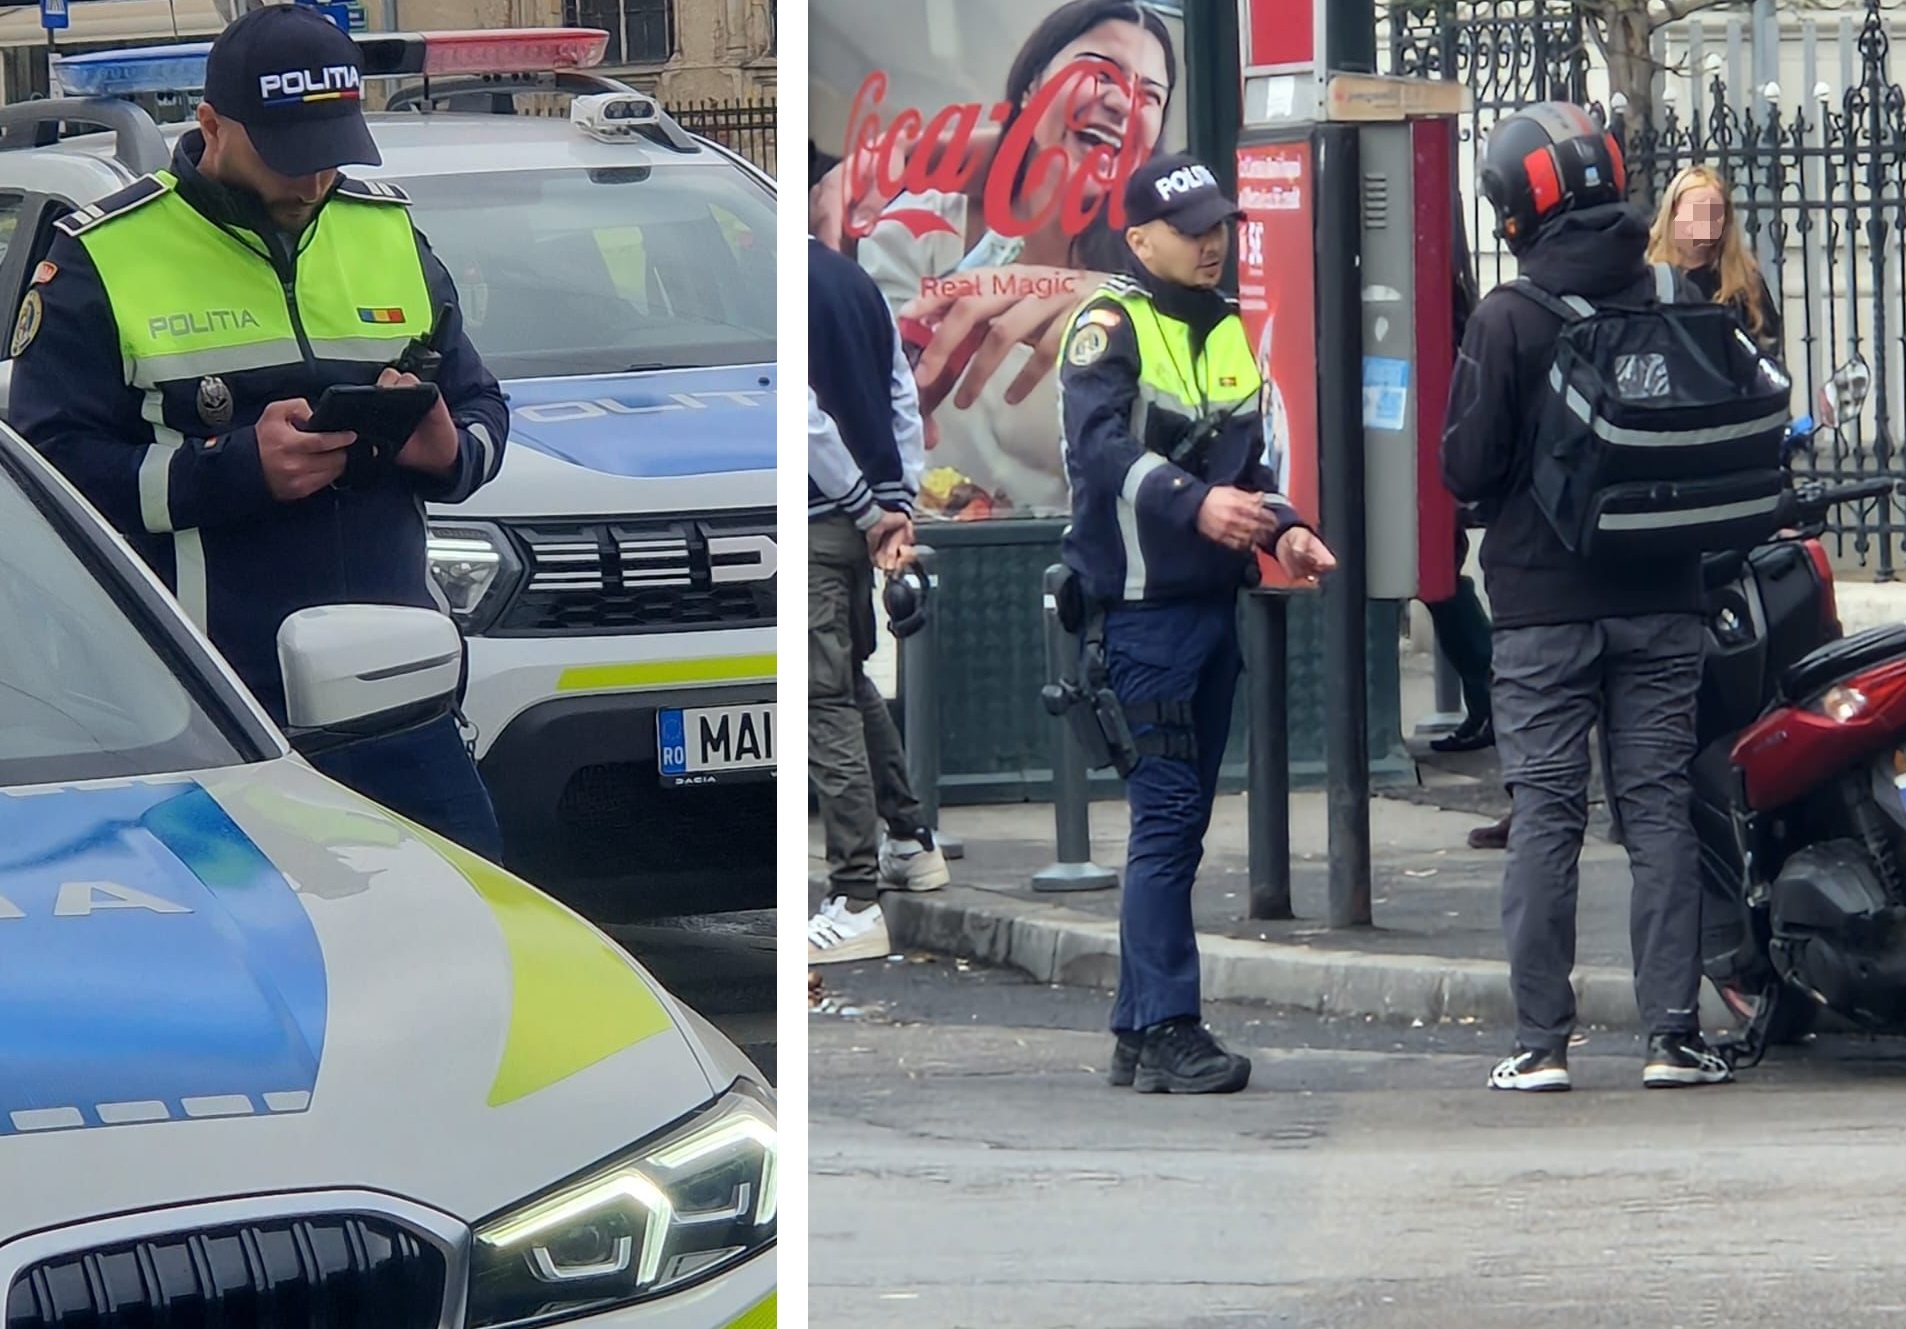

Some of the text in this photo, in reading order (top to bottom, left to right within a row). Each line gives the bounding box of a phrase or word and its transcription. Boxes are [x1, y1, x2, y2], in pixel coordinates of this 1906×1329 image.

[842, 60, 1150, 238] Coca-Col
[920, 271, 1076, 300] Real Magic
[148, 309, 261, 340] POLITIA
[514, 390, 777, 423] OLIT
[700, 711, 772, 764] MAI
[662, 746, 684, 766] RO
[675, 775, 717, 786] DACIA
